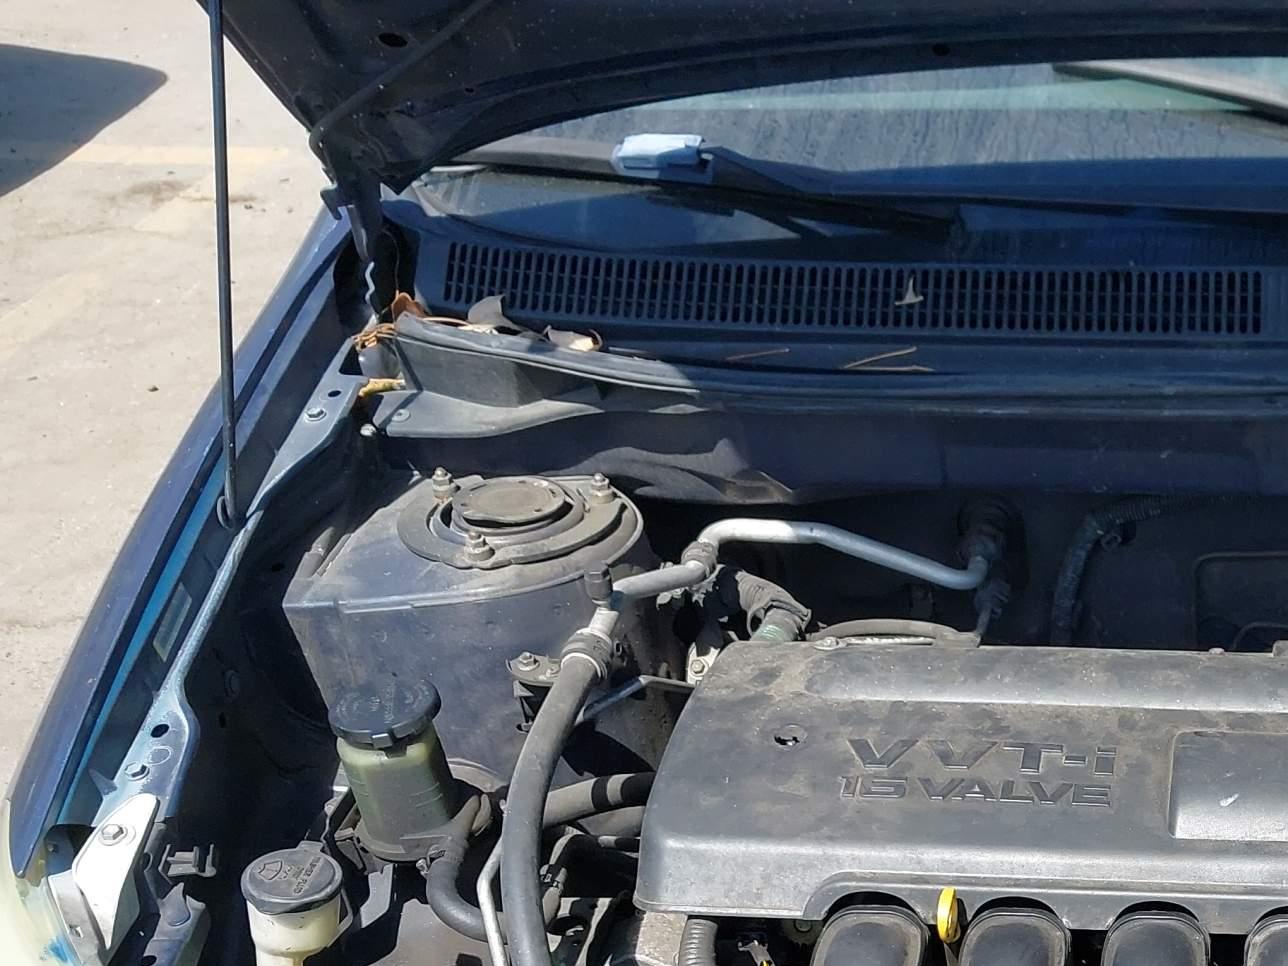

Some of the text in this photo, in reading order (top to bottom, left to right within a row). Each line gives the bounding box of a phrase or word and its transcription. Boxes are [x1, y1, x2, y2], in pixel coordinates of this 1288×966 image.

[847, 738, 1117, 776] VVT-i
[840, 775, 1112, 807] 16 VALVE
